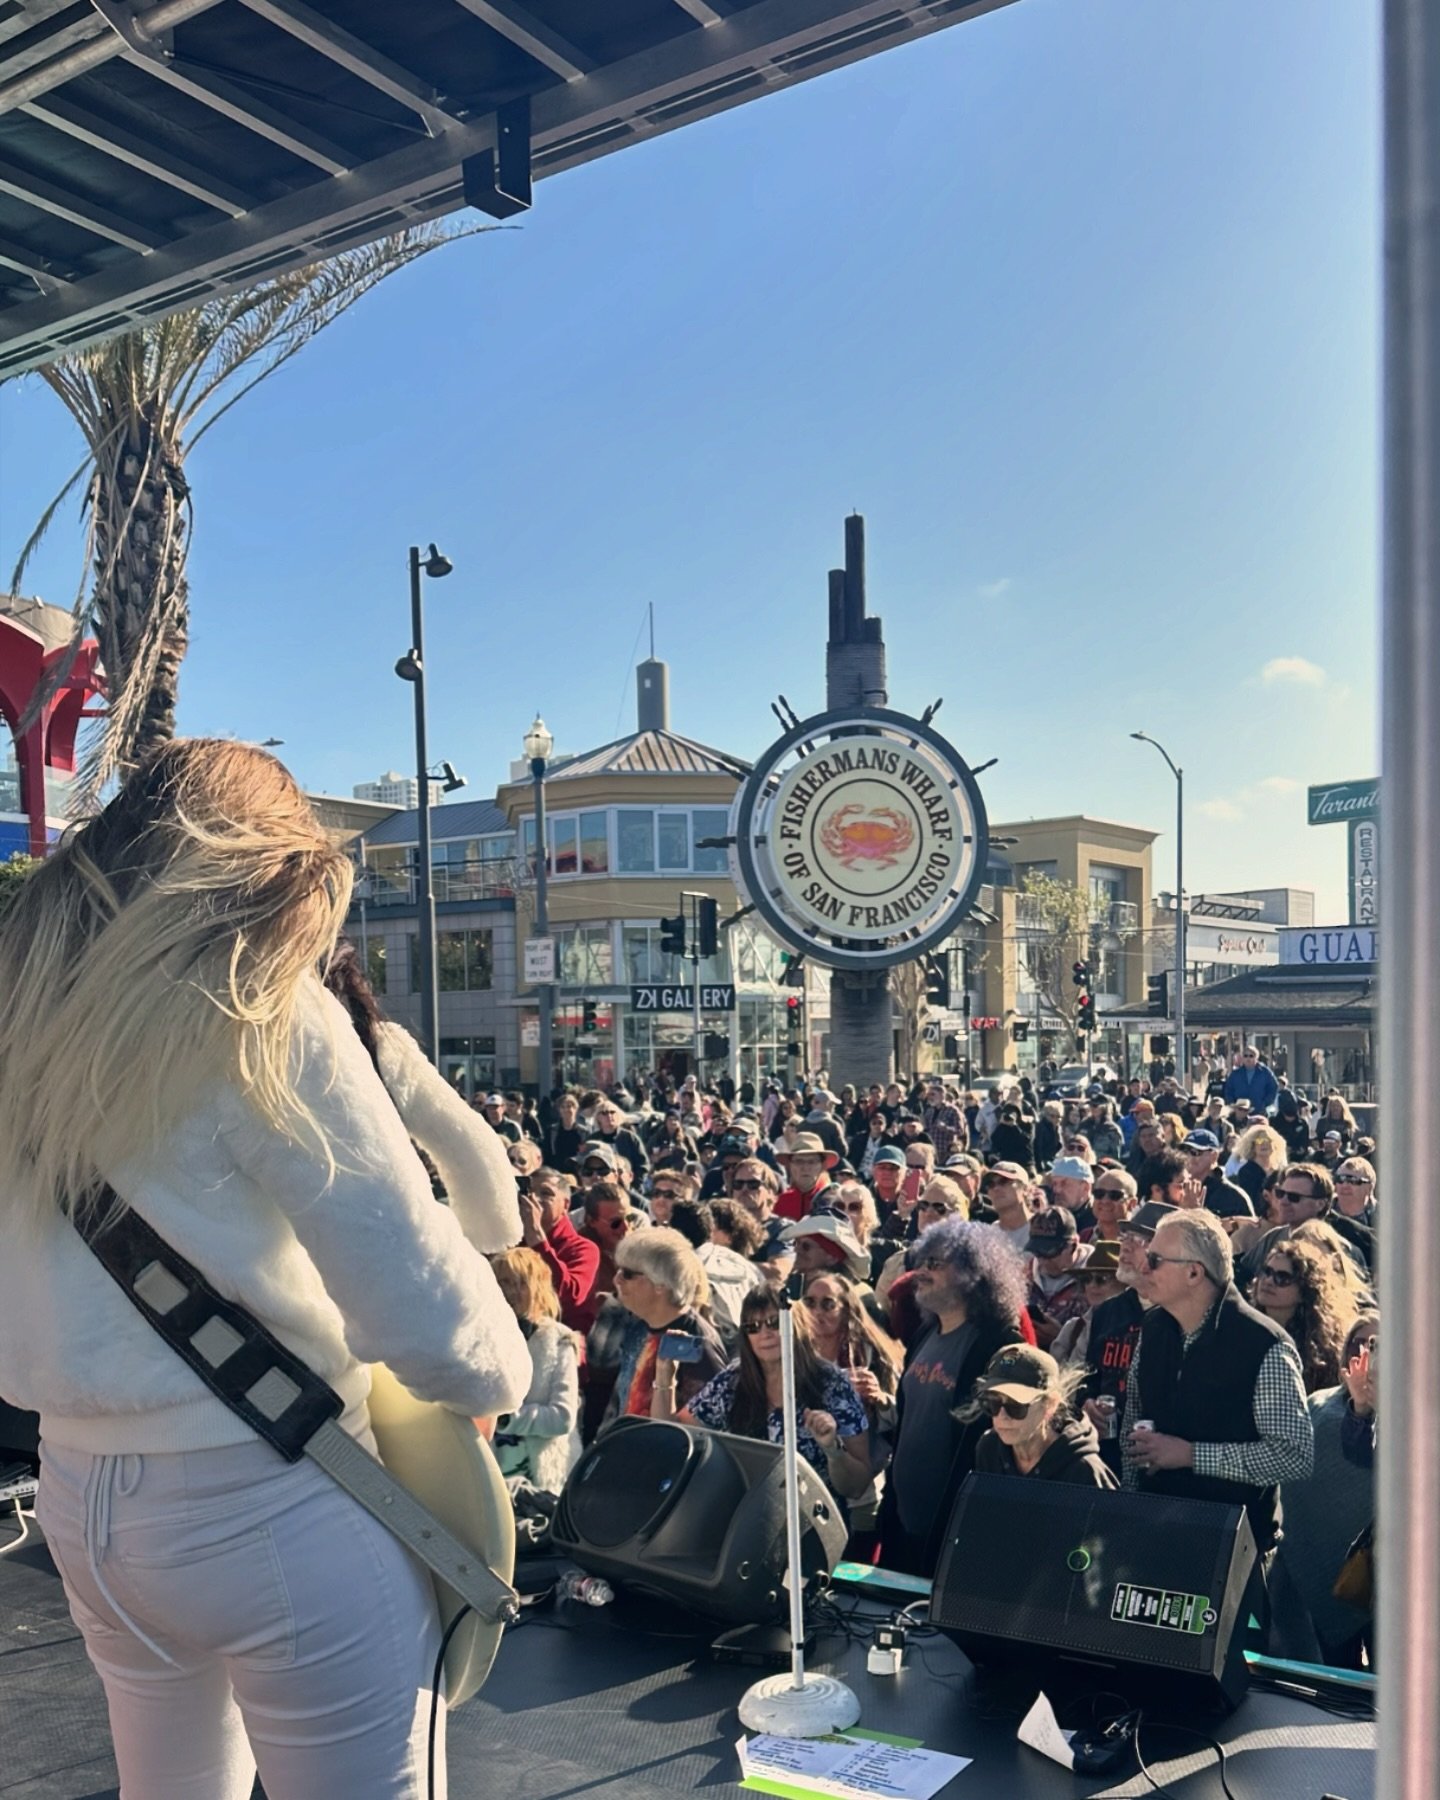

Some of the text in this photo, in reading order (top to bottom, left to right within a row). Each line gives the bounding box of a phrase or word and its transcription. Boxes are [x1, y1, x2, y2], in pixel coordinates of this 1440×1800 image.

[780, 747, 953, 842] FISHERMANS WHARF
[783, 851, 951, 929] OF SAN FRANCISCO
[1359, 828, 1374, 925] RESTAURANT
[662, 988, 731, 1008] GALERY
